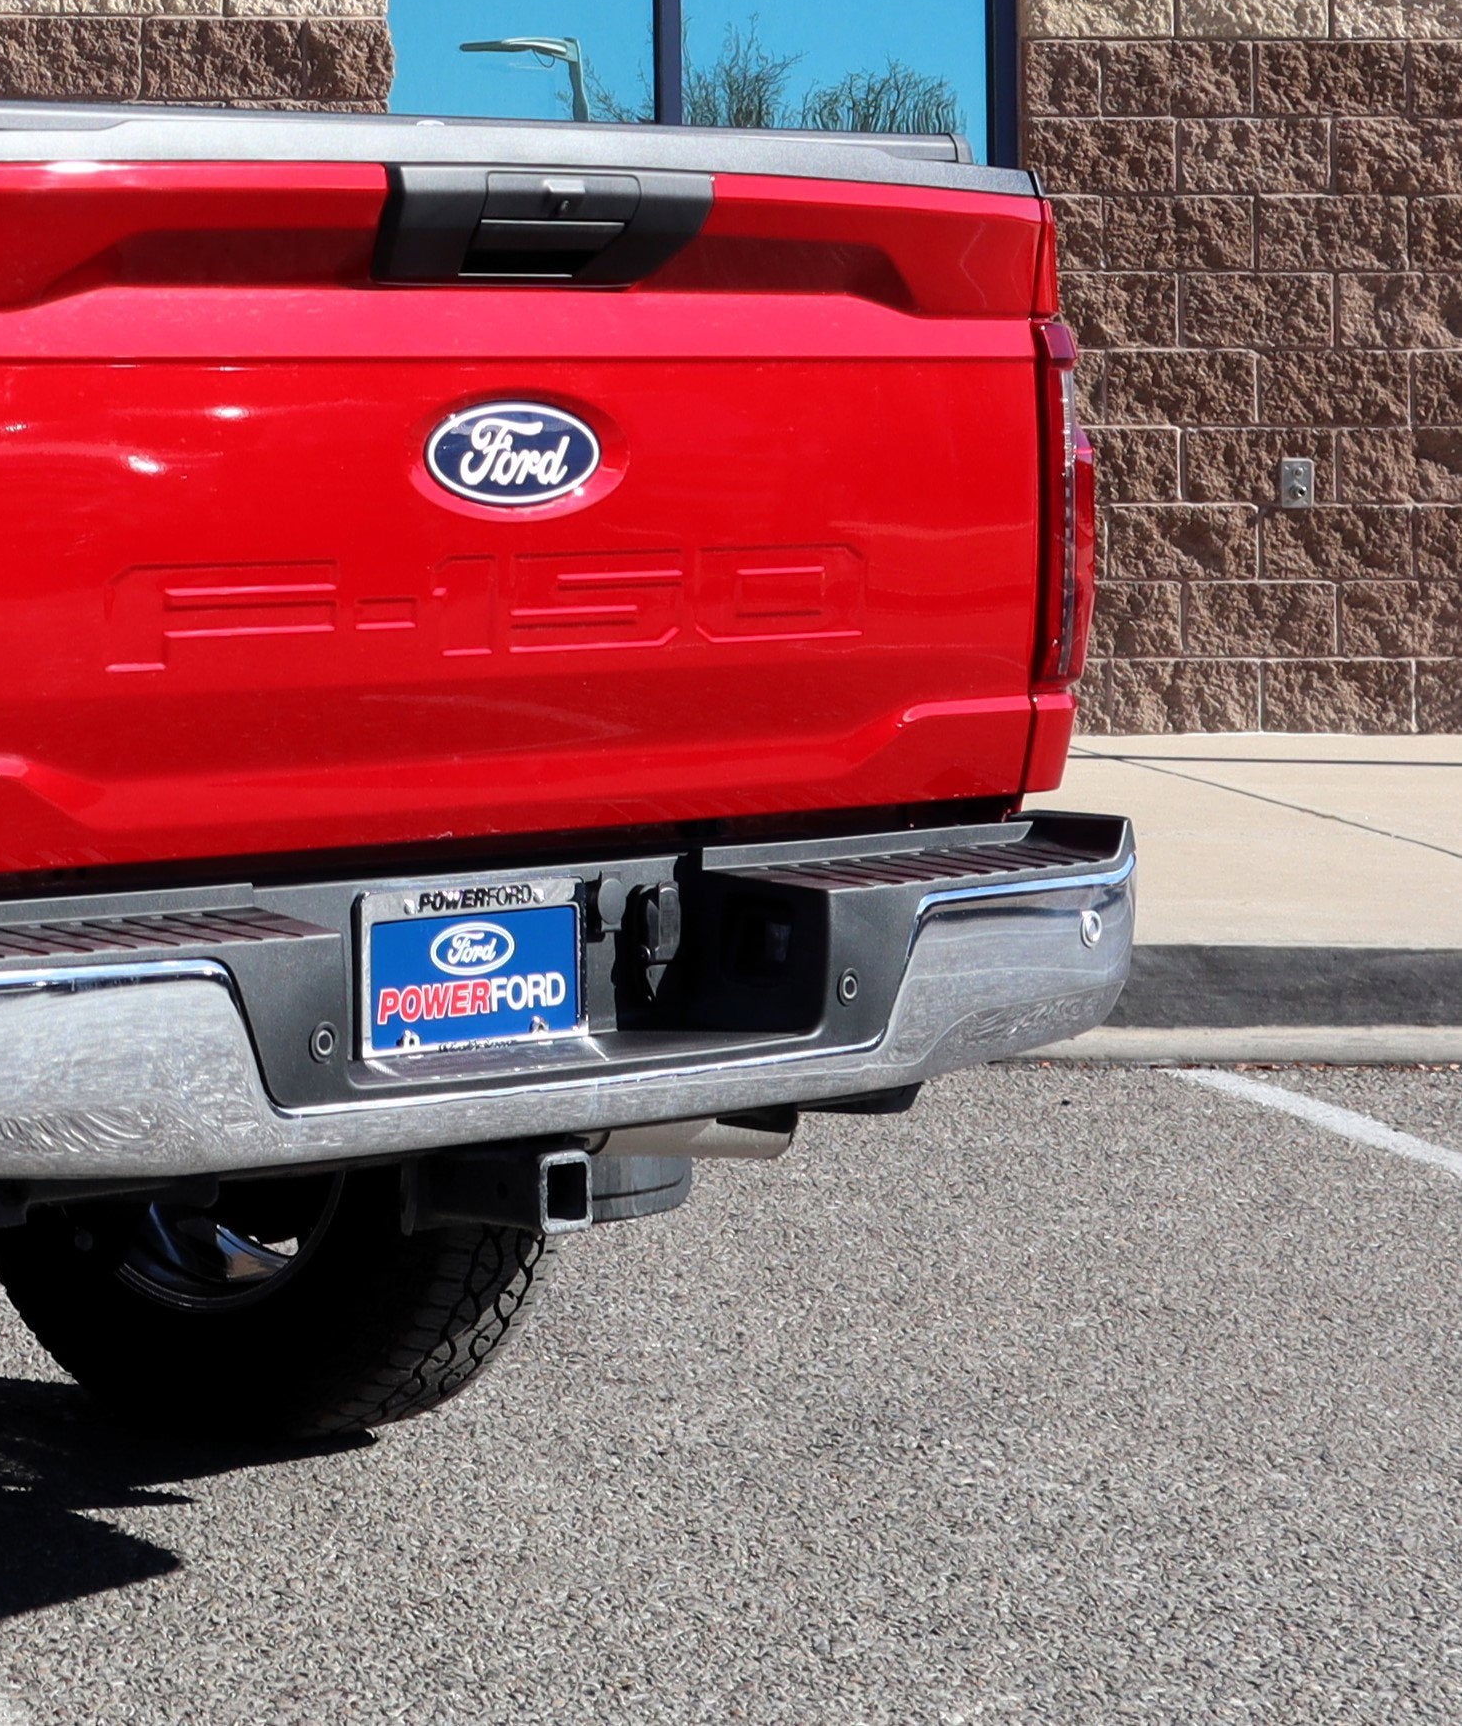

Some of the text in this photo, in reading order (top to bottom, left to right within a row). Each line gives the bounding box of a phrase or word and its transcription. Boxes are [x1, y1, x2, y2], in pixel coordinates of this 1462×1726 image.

[459, 416, 572, 488] Ford
[104, 542, 868, 672] F-150
[417, 883, 533, 913] POWERFORD
[447, 929, 498, 965] Ford
[377, 971, 567, 1026] POWERFORD
